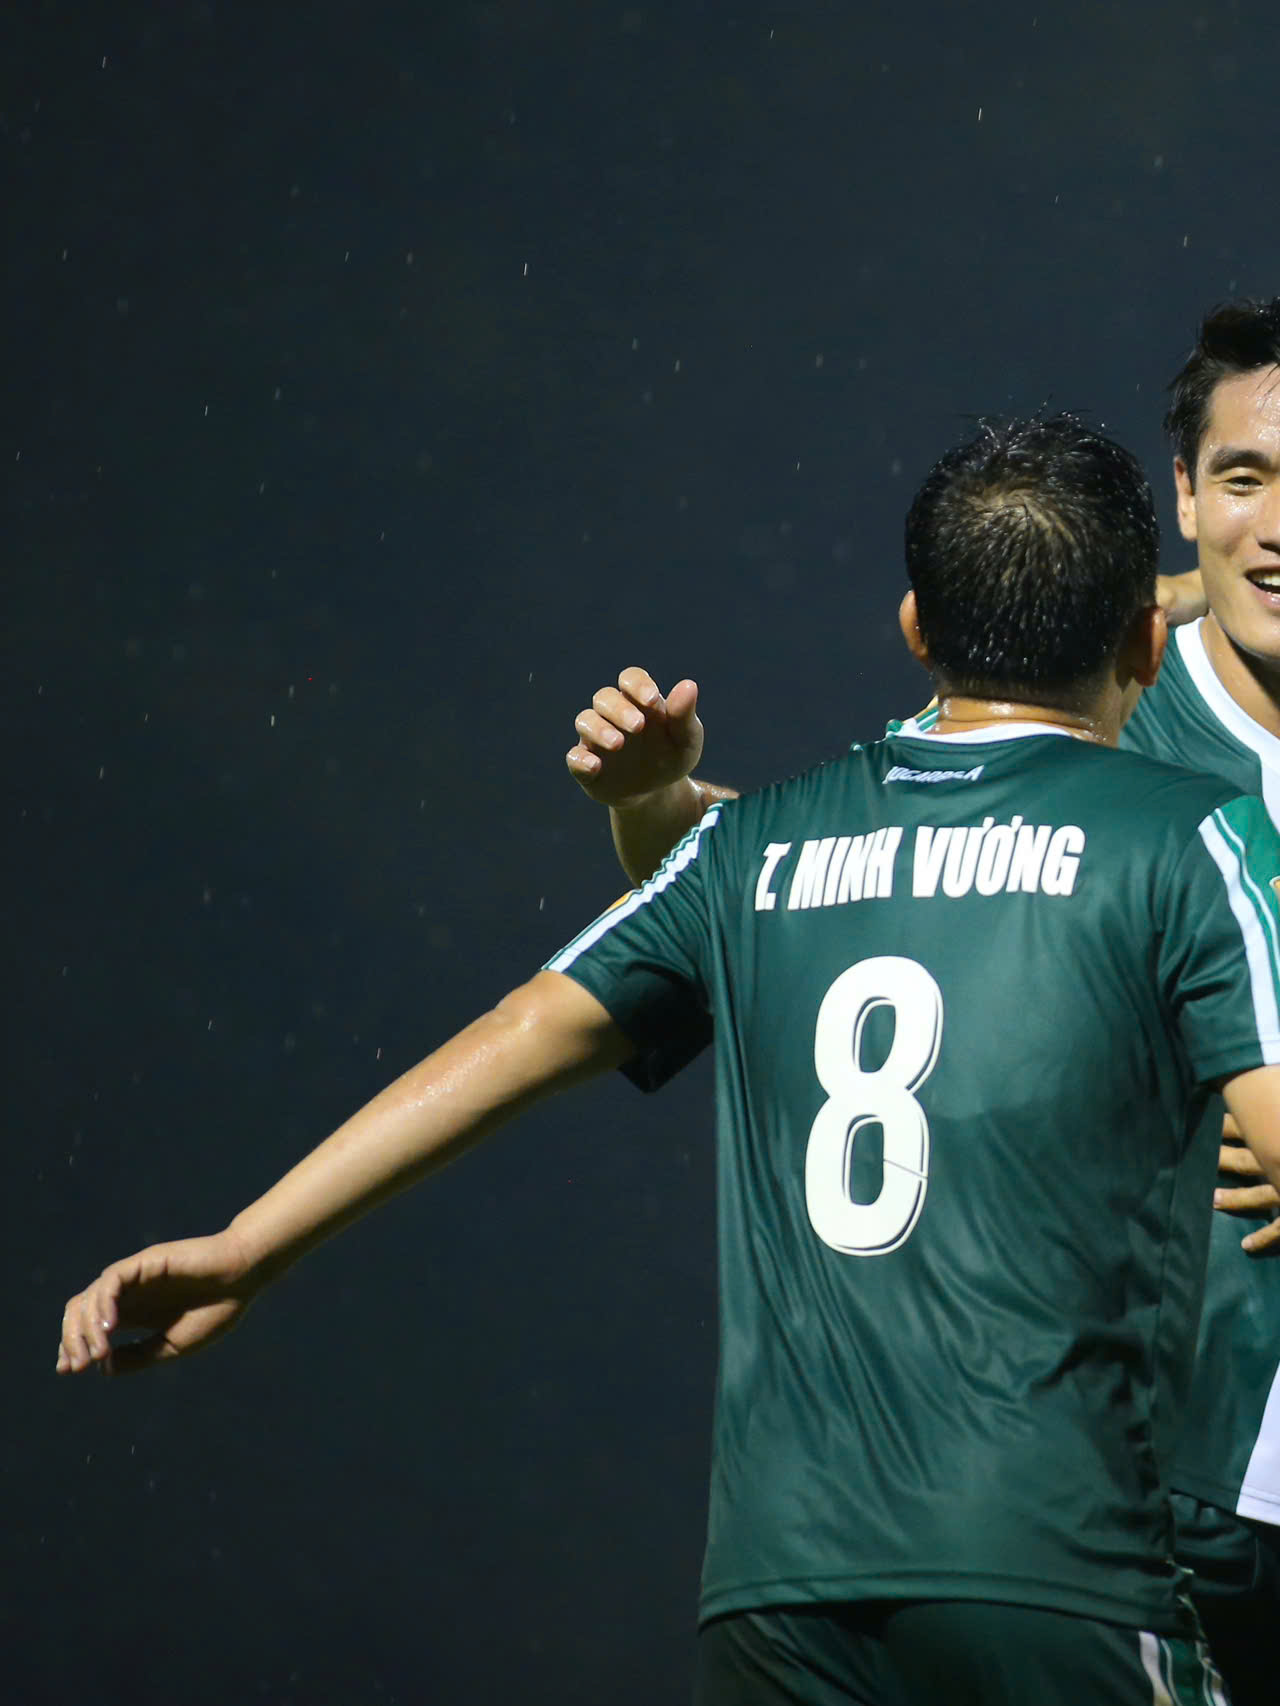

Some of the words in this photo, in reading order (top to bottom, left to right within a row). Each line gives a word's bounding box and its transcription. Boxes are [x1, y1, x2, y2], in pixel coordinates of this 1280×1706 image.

[787, 826, 903, 910] MINH
[912, 815, 1086, 898] VƯƠNG
[805, 955, 944, 1257] 8
